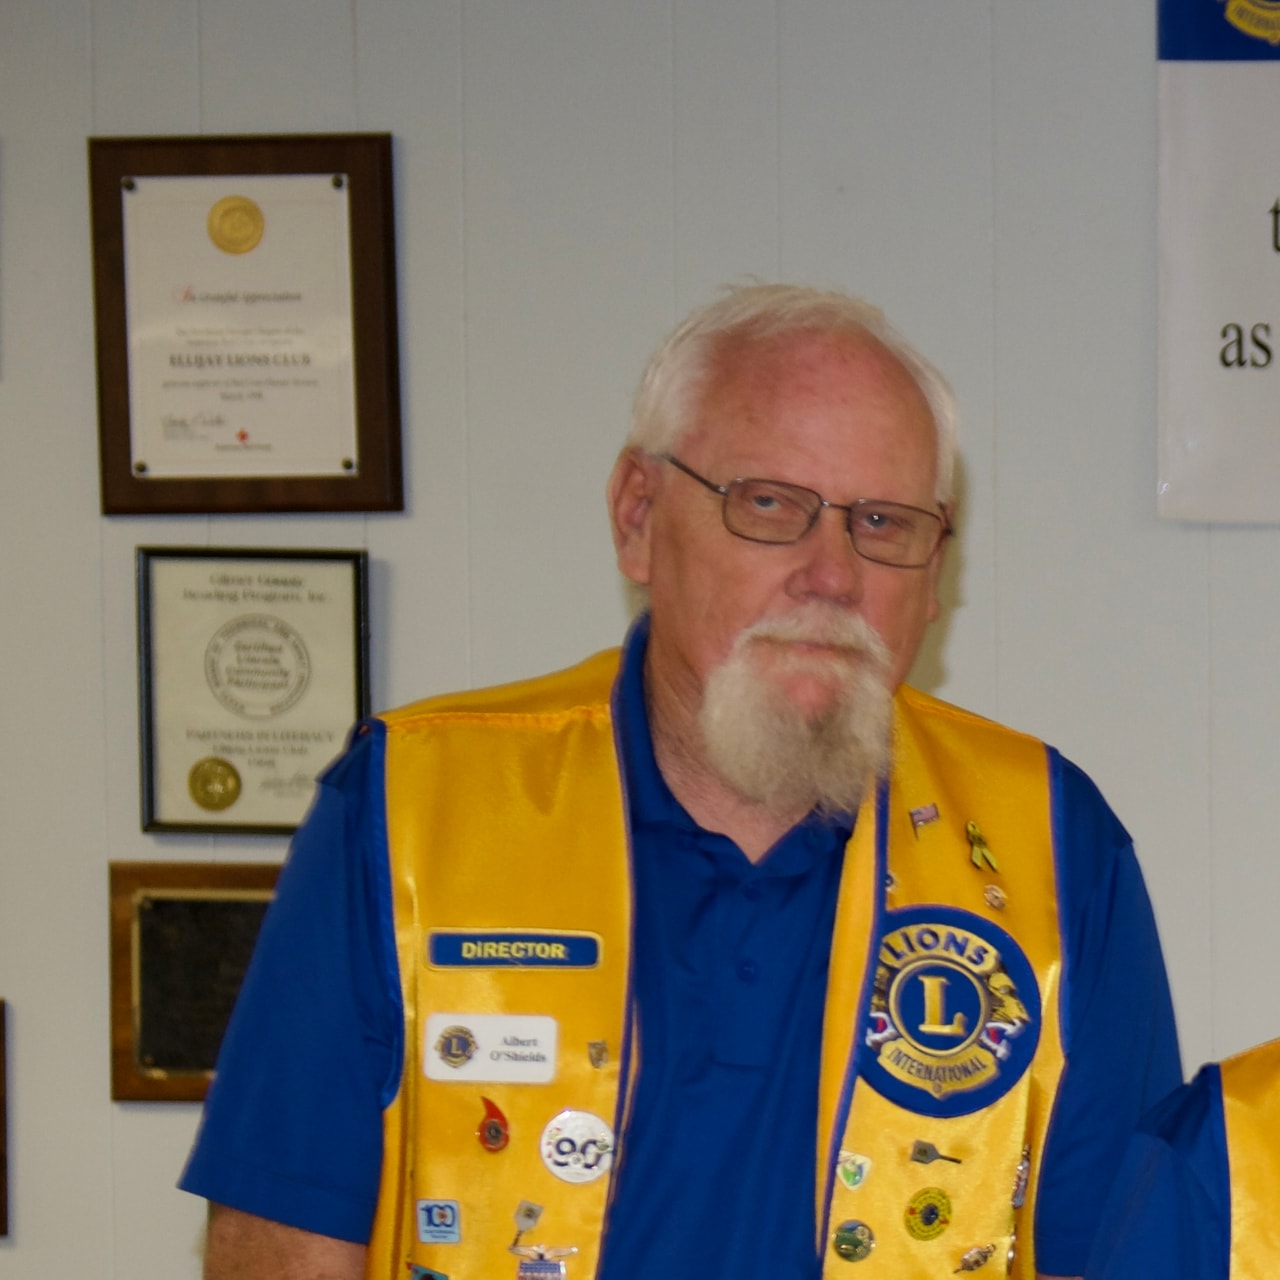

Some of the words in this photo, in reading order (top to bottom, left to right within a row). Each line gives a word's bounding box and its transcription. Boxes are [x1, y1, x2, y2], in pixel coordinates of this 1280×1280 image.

[1219, 323, 1273, 369] as
[461, 941, 568, 960] DIRECTOR
[883, 928, 990, 966] LIONS
[918, 974, 967, 1036] L
[887, 1047, 987, 1083] INTERNATIONAL
